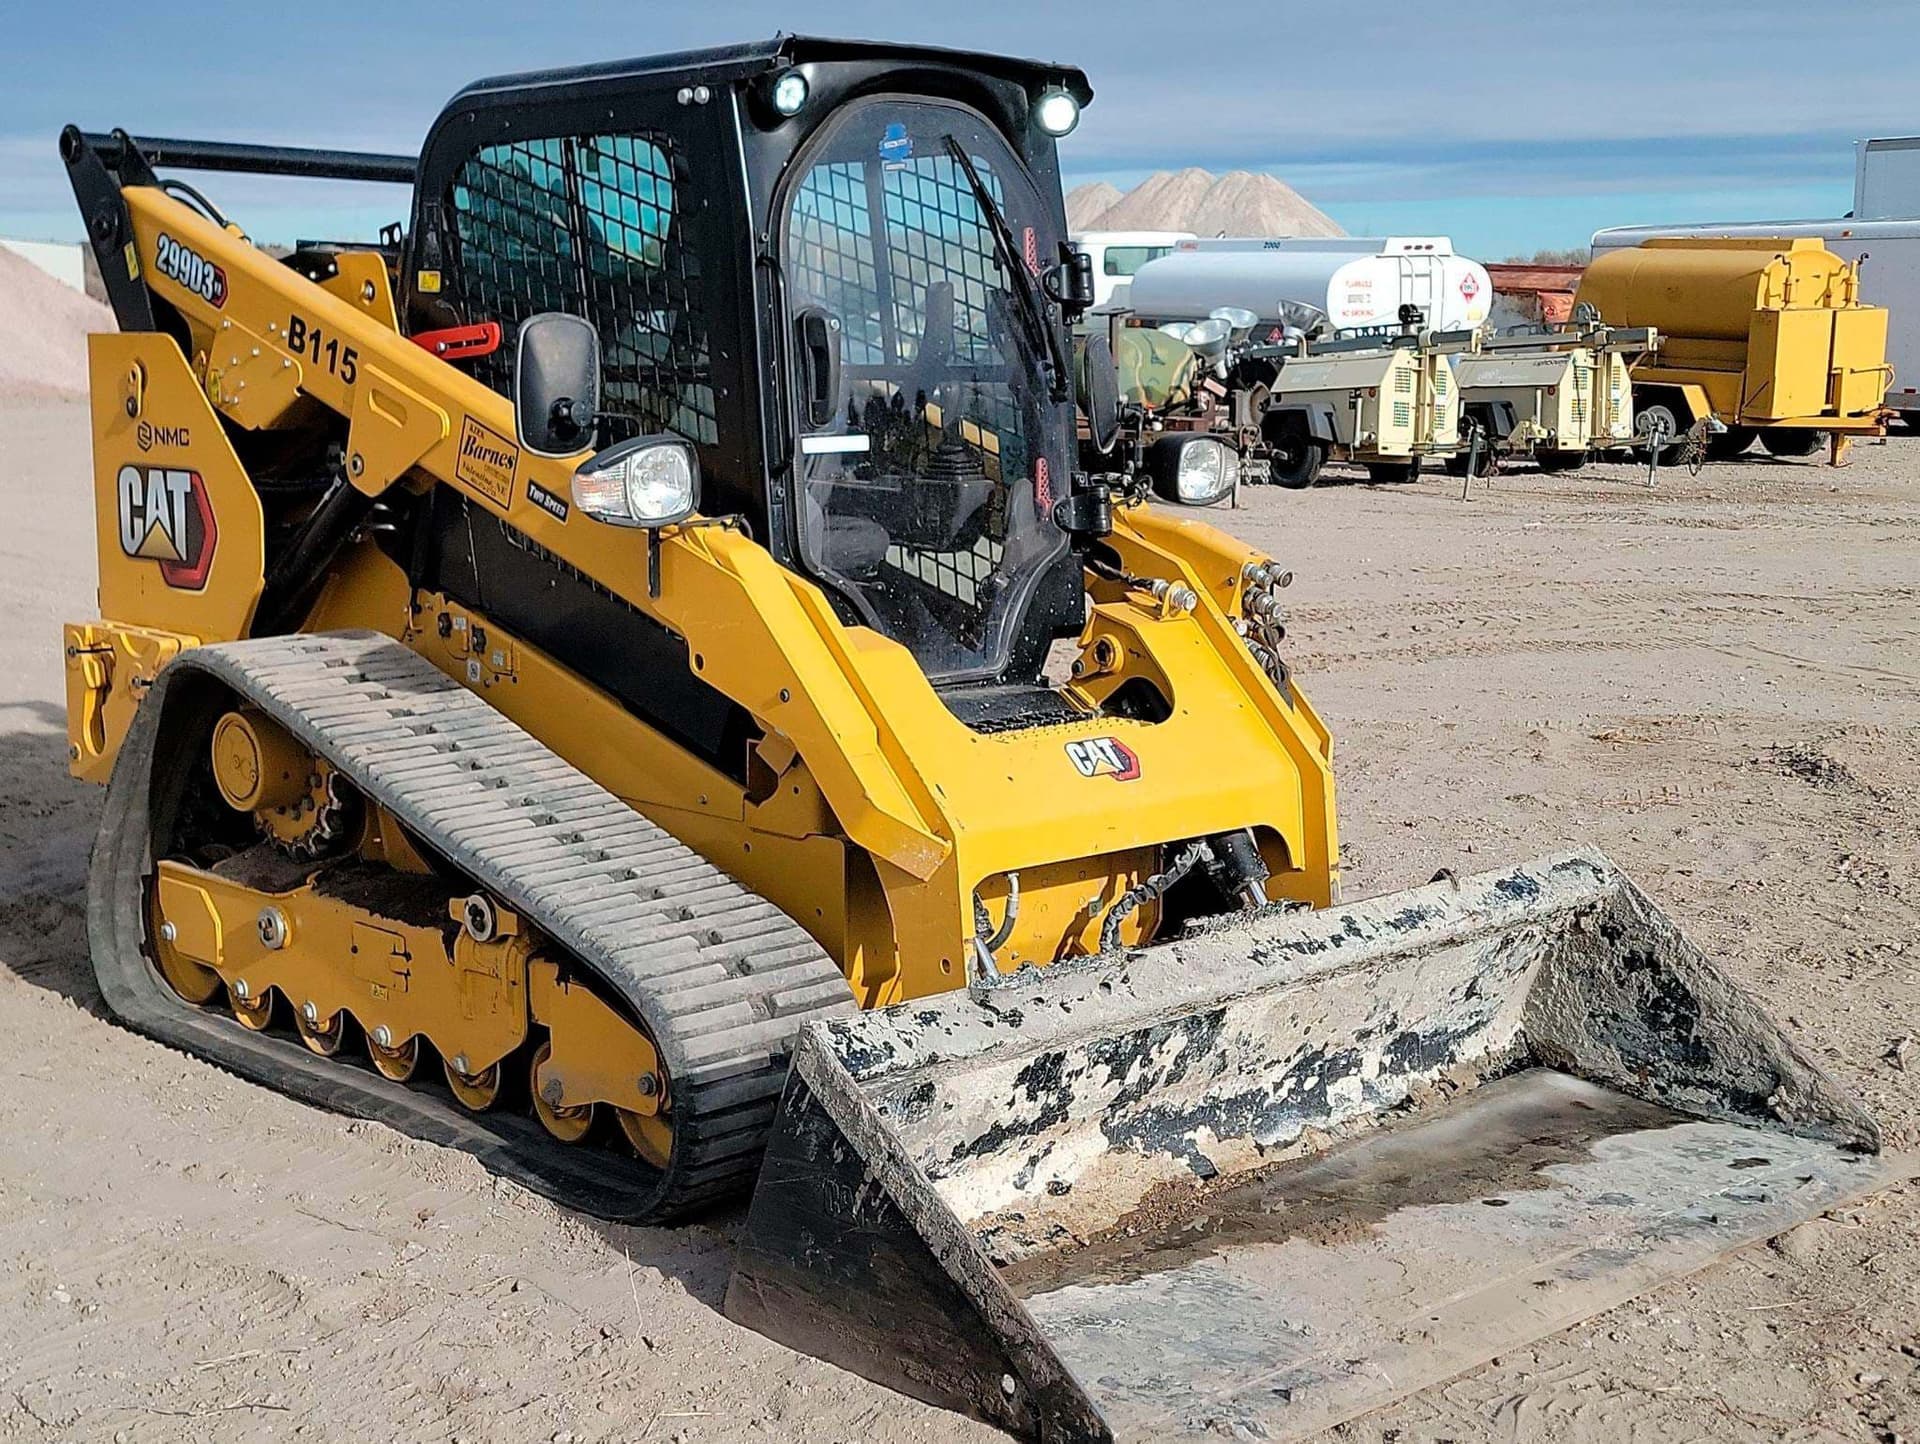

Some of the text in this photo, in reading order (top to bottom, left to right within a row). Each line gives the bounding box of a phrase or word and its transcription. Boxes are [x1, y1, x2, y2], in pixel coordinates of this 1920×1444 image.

[156, 232, 215, 301] 299D3
[288, 314, 358, 385] B115
[154, 425, 190, 447] NMC
[463, 435, 515, 470] Barnes
[118, 465, 192, 561] CAT
[1065, 737, 1126, 776] CAT
